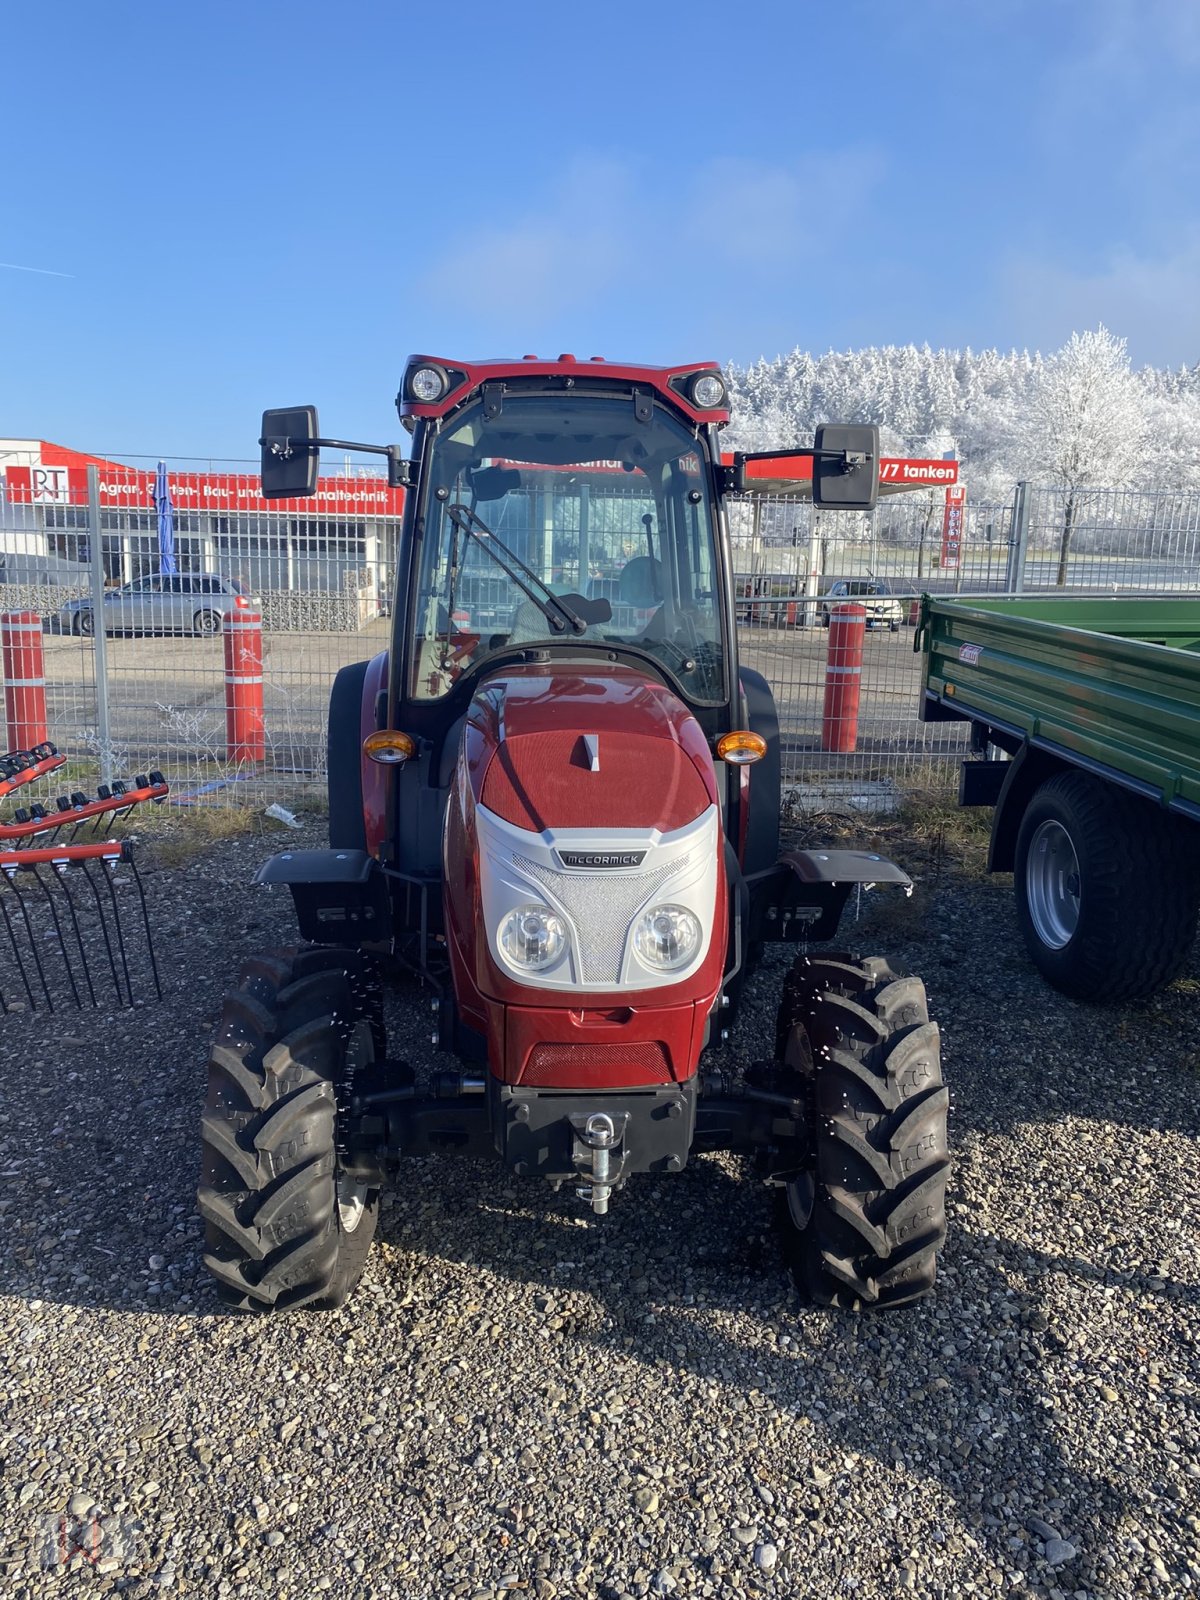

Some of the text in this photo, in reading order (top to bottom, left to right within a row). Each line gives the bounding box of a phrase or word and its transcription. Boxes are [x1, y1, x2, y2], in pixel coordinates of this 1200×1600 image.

[880, 463, 955, 479] /7 tanken
[203, 484, 234, 497] Bau-
[237, 486, 263, 498] und
